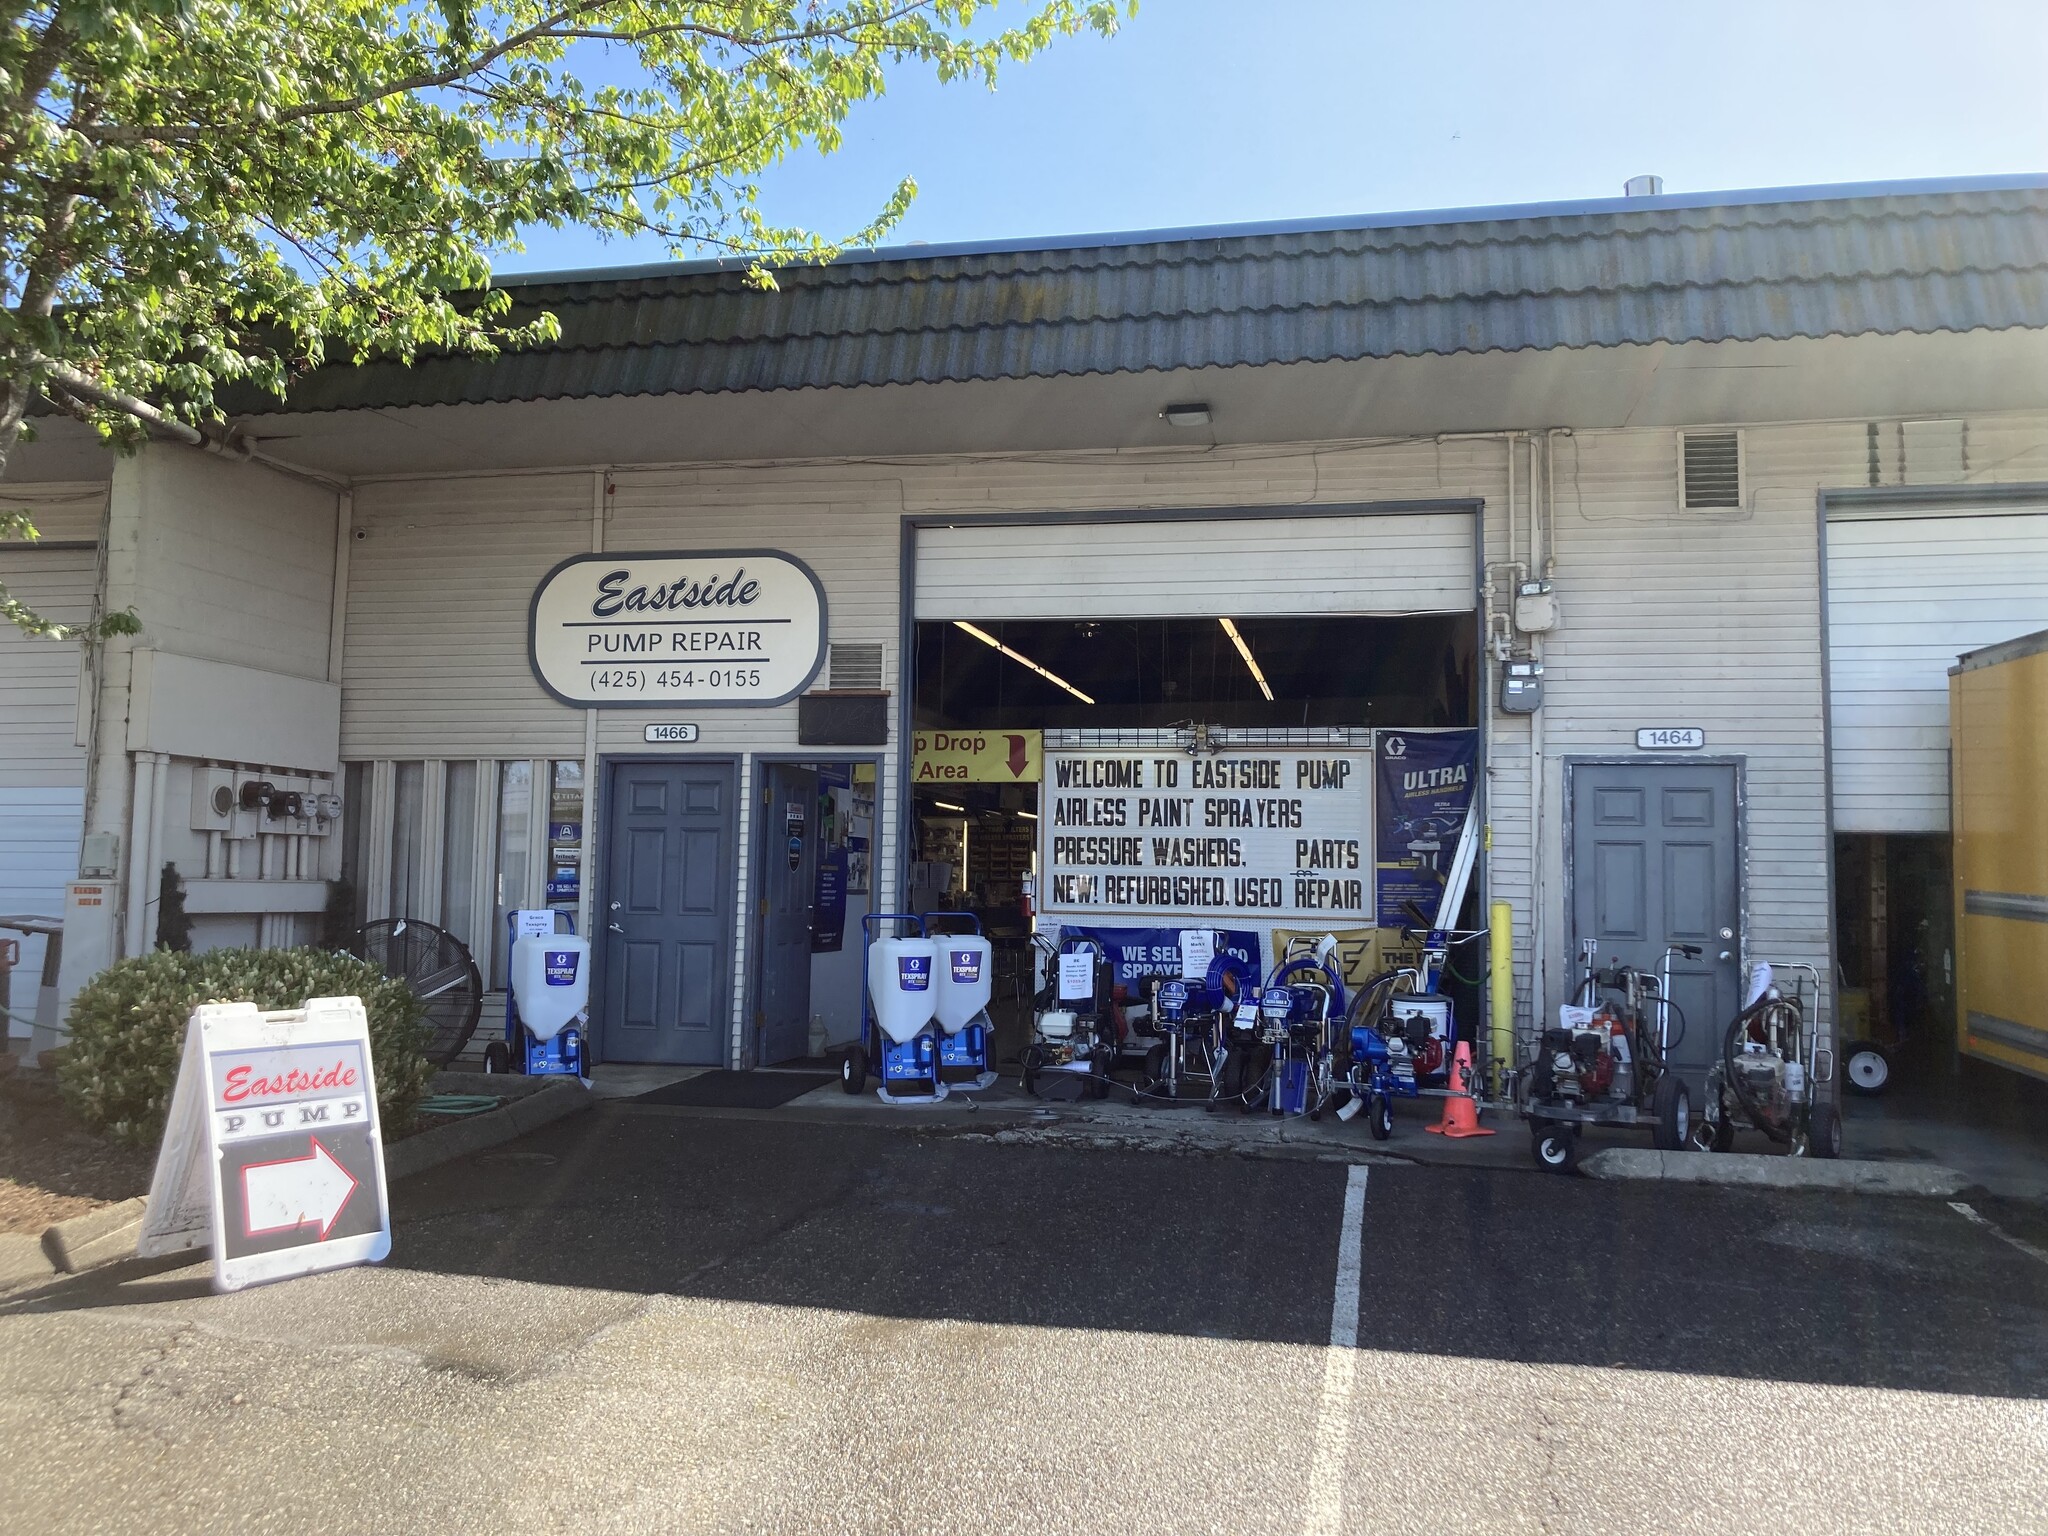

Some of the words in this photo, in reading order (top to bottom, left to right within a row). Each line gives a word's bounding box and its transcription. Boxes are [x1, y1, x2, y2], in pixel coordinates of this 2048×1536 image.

[592, 567, 760, 618] Eastside
[588, 633, 662, 652] PUMP
[672, 631, 761, 651] REPAIR
[590, 670, 647, 692] (425)
[656, 669, 761, 688] 454-0155
[653, 727, 688, 739] 1466
[935, 733, 986, 755] Drop
[1649, 730, 1693, 745] 1464
[918, 761, 968, 779] Area
[1056, 759, 1143, 788] WELCOME
[1153, 759, 1178, 788] TO
[1192, 759, 1281, 789] EASTSIDE
[1296, 759, 1351, 789] PUMP
[1403, 764, 1468, 790] ULTRA
[1404, 790, 1430, 798] AIRLESS
[1054, 798, 1127, 827] AIRLESS
[1138, 798, 1194, 828] PAINT
[1204, 798, 1302, 828] SPRAYERS
[1053, 836, 1143, 866] PRESSURE
[1295, 839, 1359, 869] PARTS
[1053, 874, 1098, 904] NEW!
[1234, 878, 1282, 907] USED
[1294, 878, 1362, 909] REPAIR
[1122, 946, 1149, 962] WE
[1151, 946, 1182, 962] SEL
[1382, 952, 1413, 964] THE
[901, 972, 928, 980] TEXSPRAY
[1122, 964, 1182, 979] SPRAYE
[222, 1060, 358, 1102] Eastside
[224, 1102, 363, 1132] PUMP
